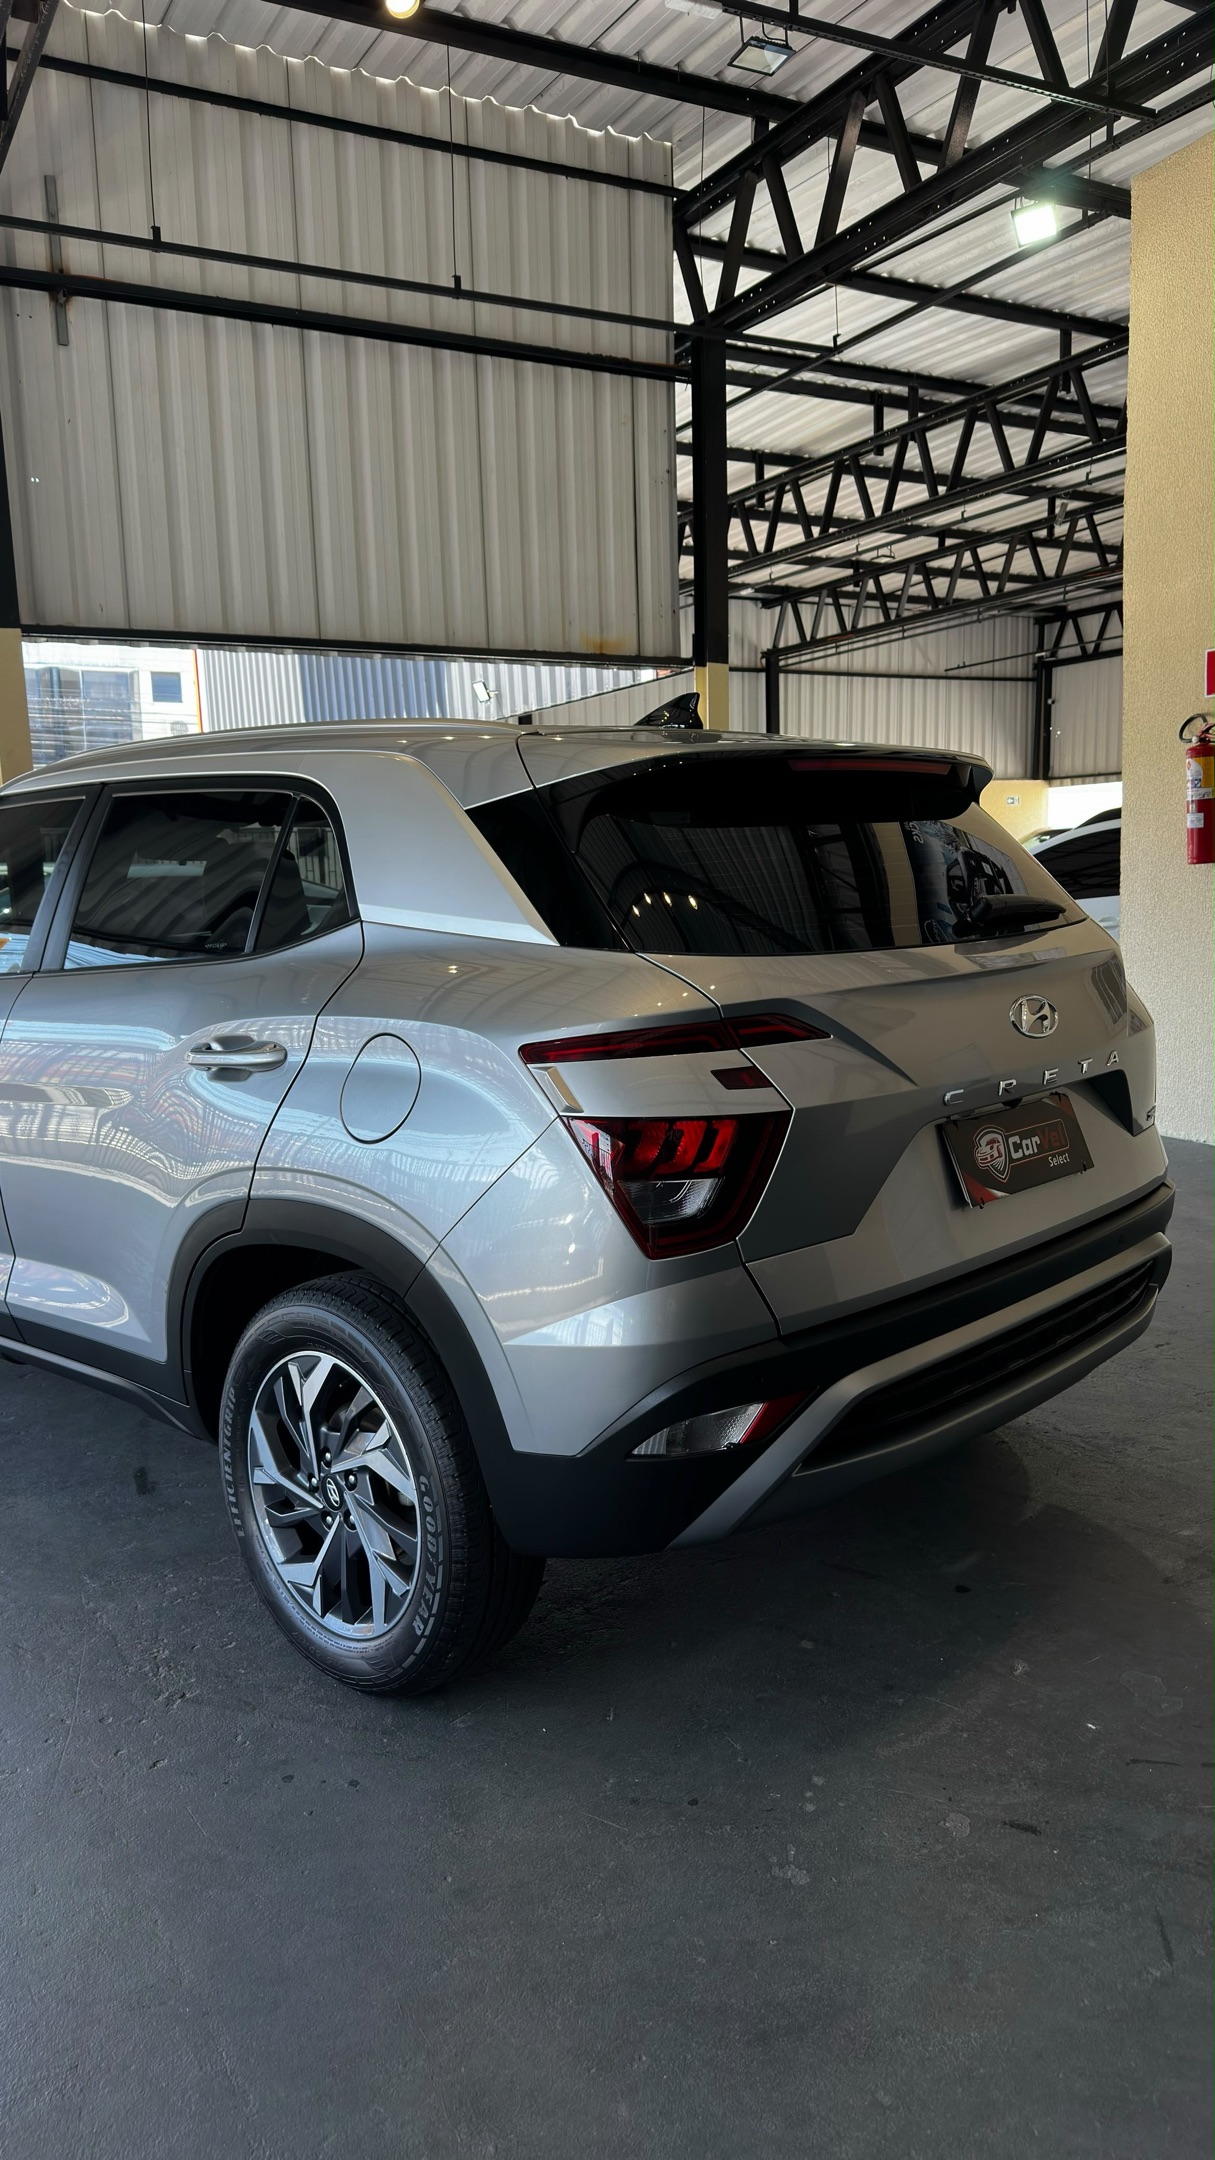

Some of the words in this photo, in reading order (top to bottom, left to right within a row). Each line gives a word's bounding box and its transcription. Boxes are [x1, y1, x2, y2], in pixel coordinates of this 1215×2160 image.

[944, 1050, 1119, 1106] CRETA
[1008, 1122, 1066, 1159] CarVel
[1048, 1152, 1070, 1167] Select
[412, 1475, 437, 1636] GOODYEAR
